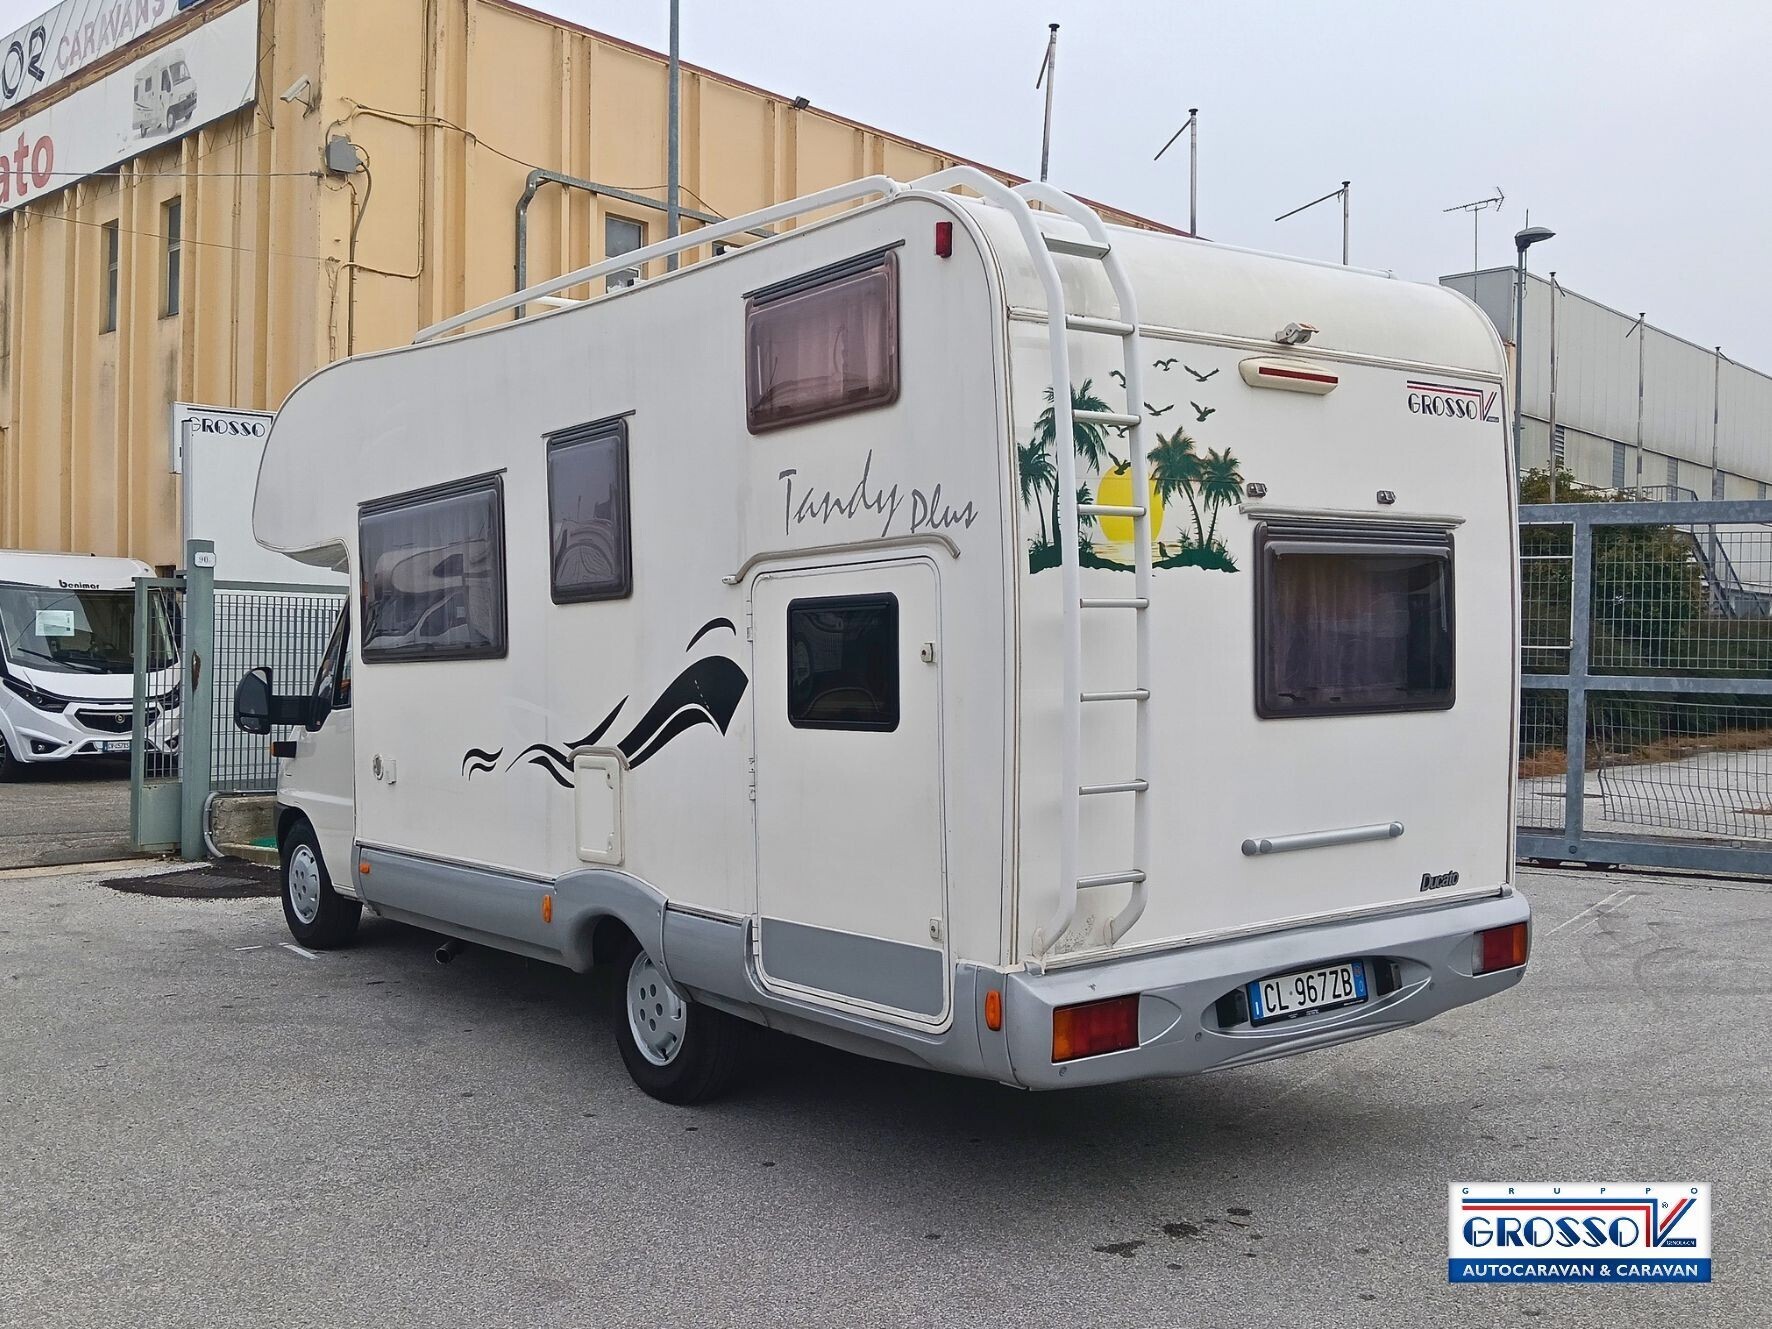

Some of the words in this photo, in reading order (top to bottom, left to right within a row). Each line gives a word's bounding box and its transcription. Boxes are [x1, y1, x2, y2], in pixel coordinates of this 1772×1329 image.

[1408, 393, 1478, 420] GROSSO
[779, 449, 904, 537] Tandy
[59, 579, 100, 590] benimar
[1420, 870, 1459, 892] Ducato
[1264, 982, 1289, 1013] CL
[1294, 968, 1354, 1006] 967ZB
